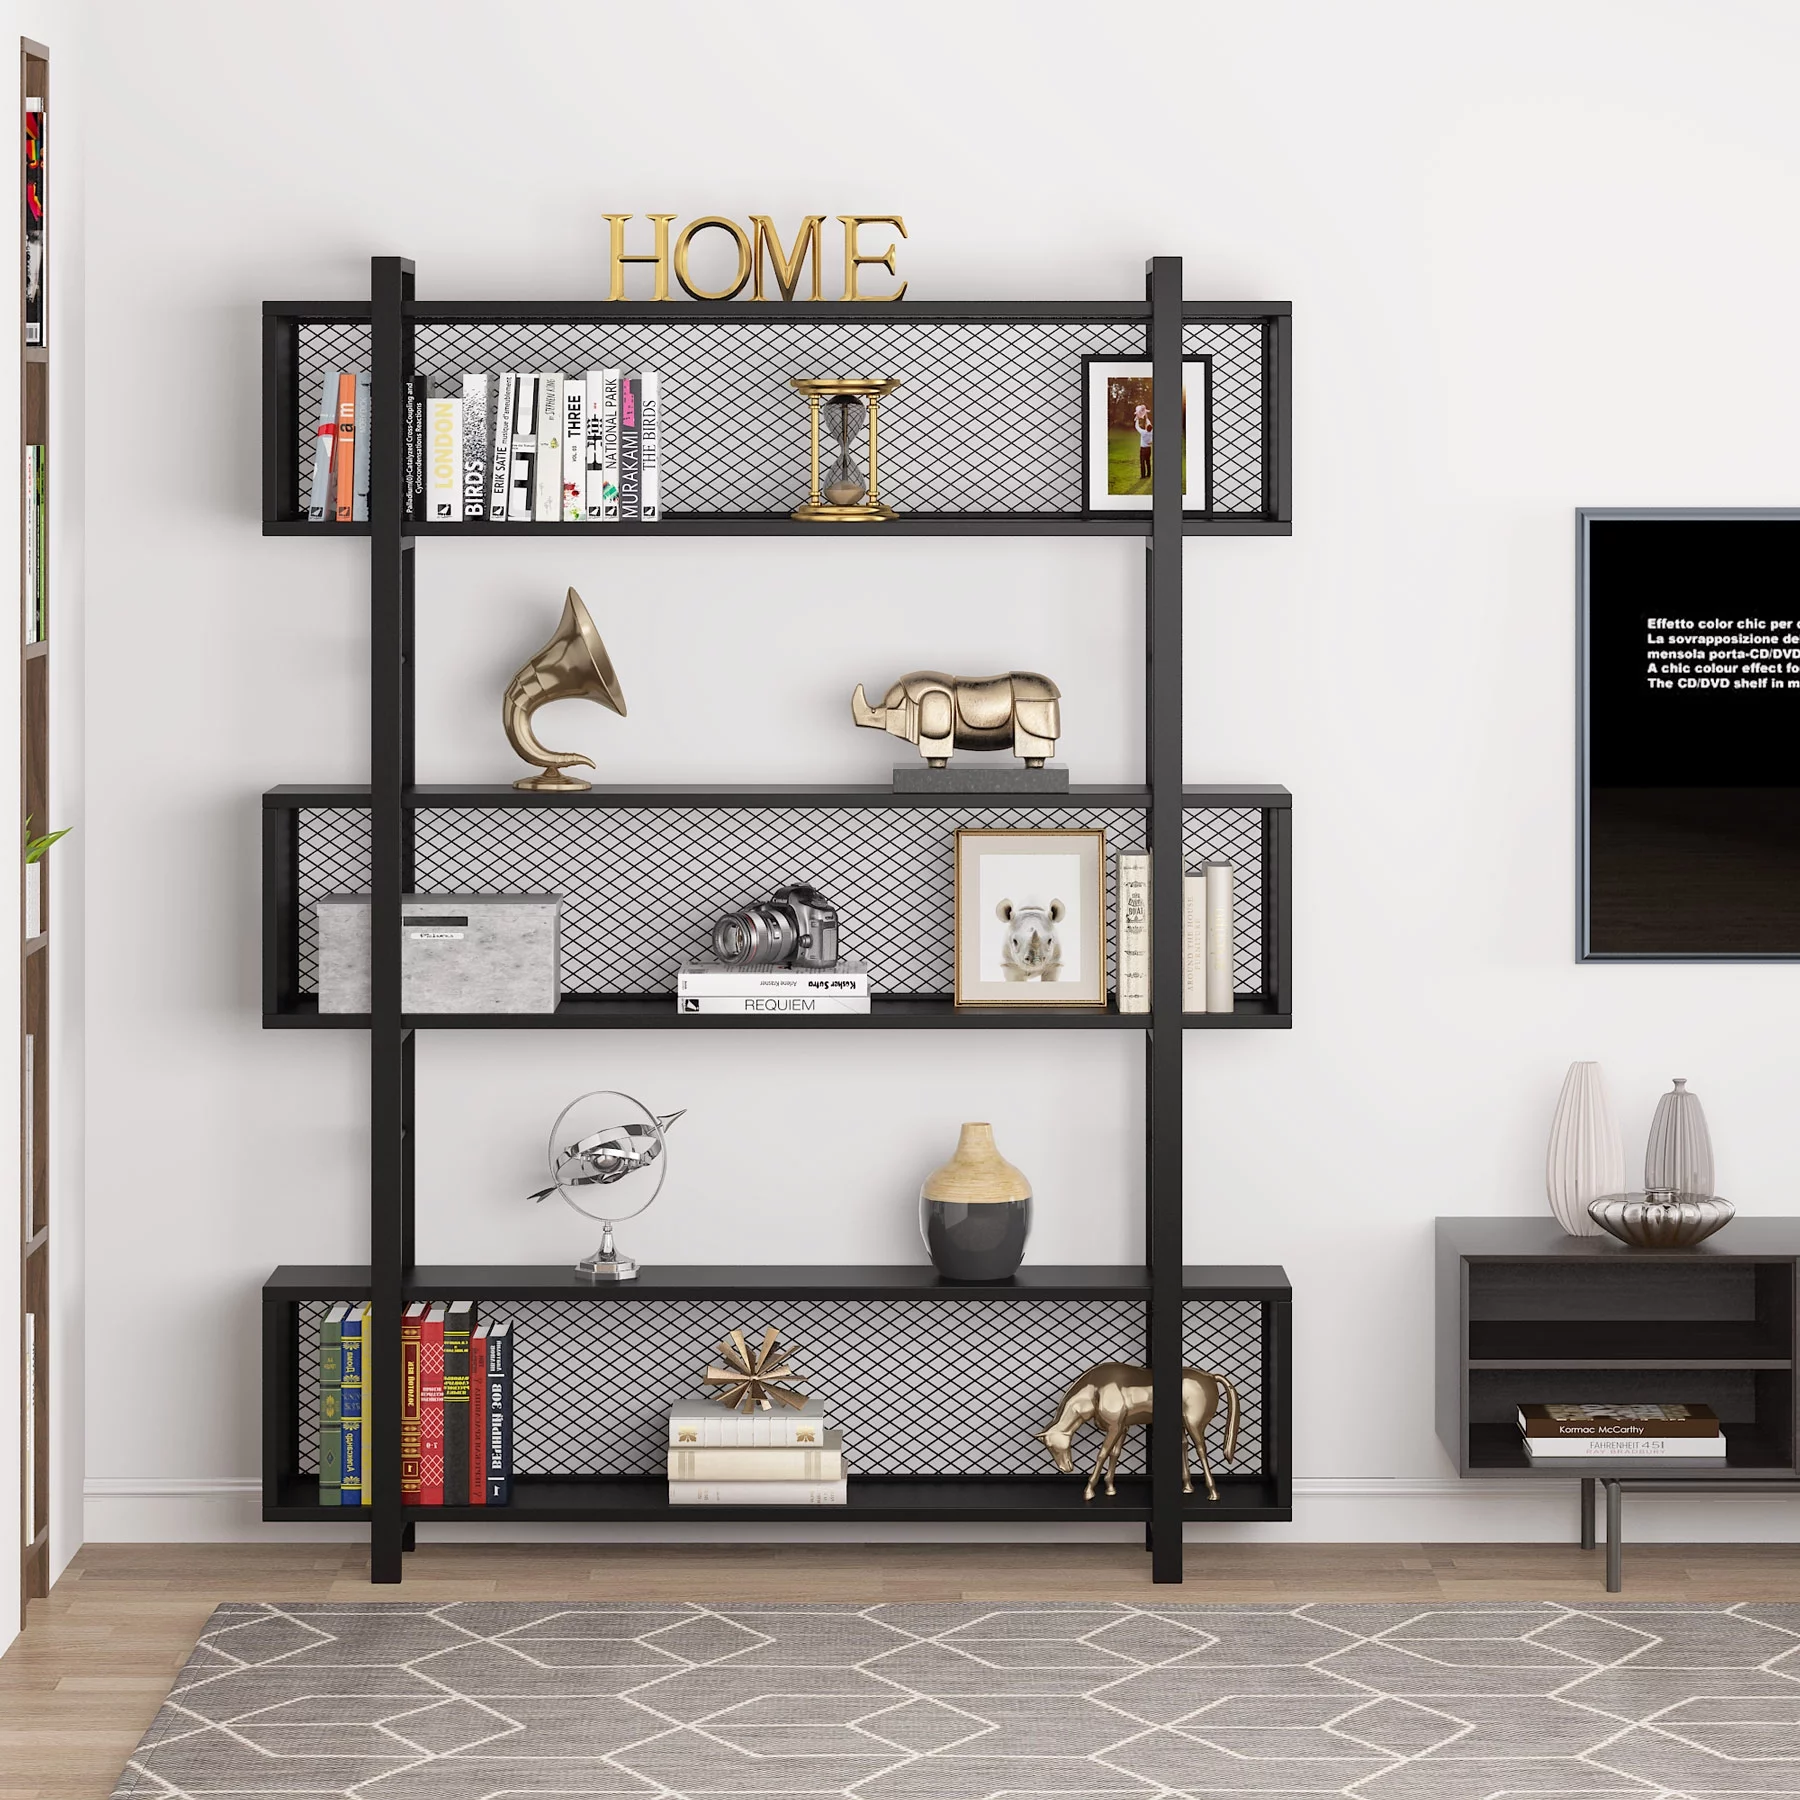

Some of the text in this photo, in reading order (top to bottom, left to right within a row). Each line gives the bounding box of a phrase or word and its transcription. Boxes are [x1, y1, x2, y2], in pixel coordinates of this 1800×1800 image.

[601, 213, 908, 301] HOME
[340, 402, 354, 418] m
[568, 395, 581, 438] THREE
[406, 396, 415, 442] Cross-Coupling
[605, 378, 617, 469] NATIONAL PARK
[340, 423, 354, 433] a
[501, 421, 509, 445] musique
[643, 400, 656, 471] THE BIRDS
[434, 402, 454, 489] LONDON
[494, 446, 507, 494] ERIK SATIE
[622, 431, 638, 518] MURAKAMI
[465, 460, 484, 516] BIRDS
[1648, 618, 1694, 629] Effetto
[1698, 618, 1733, 629] color
[1737, 618, 1766, 629] chic
[1771, 621, 1793, 631] per
[1648, 634, 1664, 644] La
[1669, 634, 1778, 646] sovrapposizione
[1648, 649, 1705, 659] mensola
[1648, 663, 1657, 673] A
[1661, 663, 1690, 673] chic
[1695, 663, 1738, 673] colour
[1742, 663, 1782, 673] effect
[1647, 678, 1673, 688] The
[1678, 678, 1730, 688] CD/DVD
[1734, 678, 1768, 688] shelf
[1772, 678, 1784, 688] in
[808, 981, 829, 990] Sutra
[745, 999, 815, 1011] REQUIEM
[1560, 1425, 1645, 1435] Kormac McCarthy
[1590, 1441, 1665, 1449] FAHRENHEIT 451
